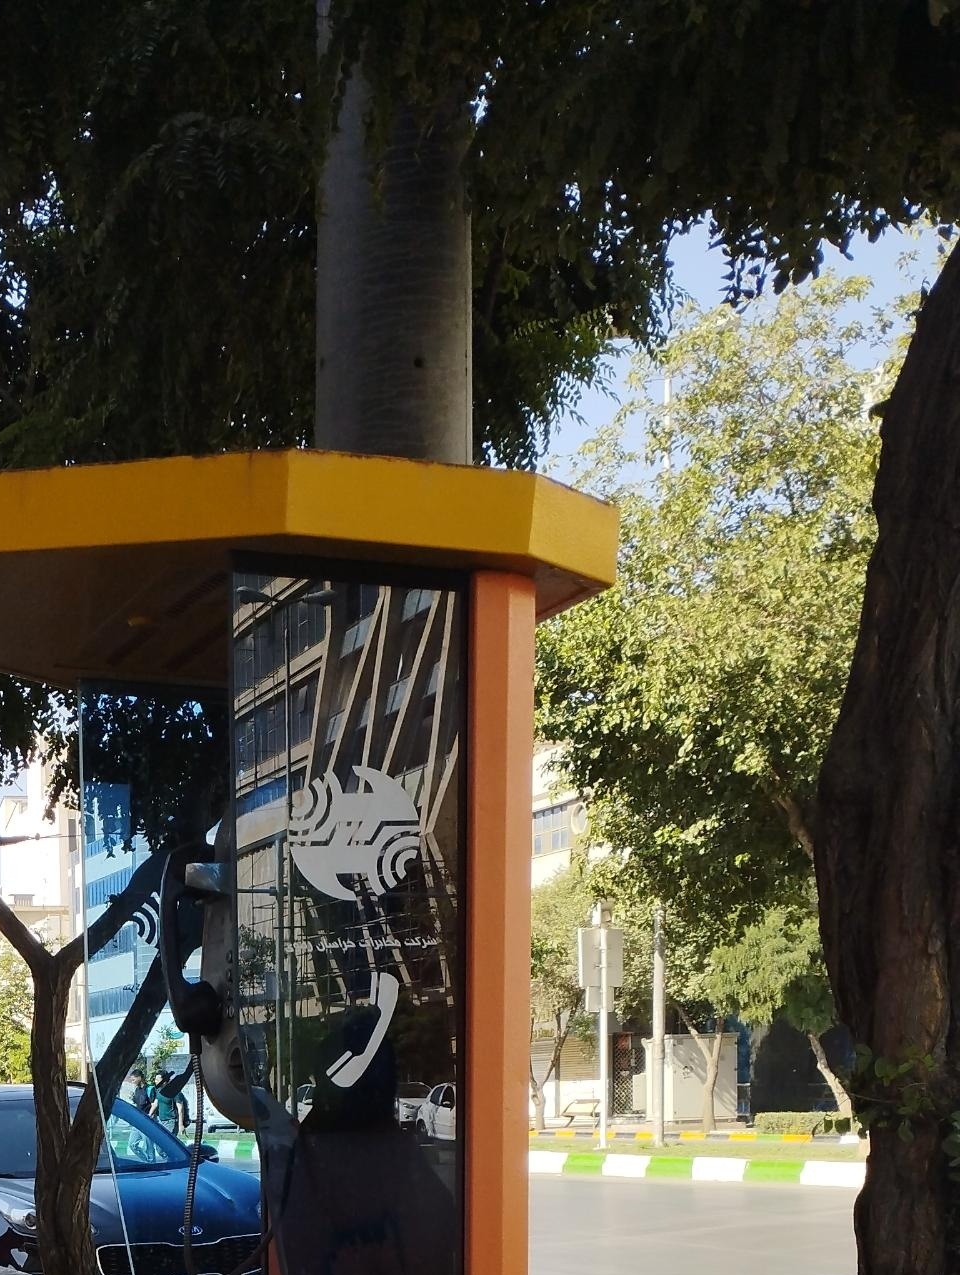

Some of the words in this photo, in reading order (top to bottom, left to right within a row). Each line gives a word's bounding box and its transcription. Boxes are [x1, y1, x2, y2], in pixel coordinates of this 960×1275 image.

[316, 936, 357, 954] خراسان
[358, 936, 401, 951] مخابرات
[404, 934, 439, 949] شرکت
